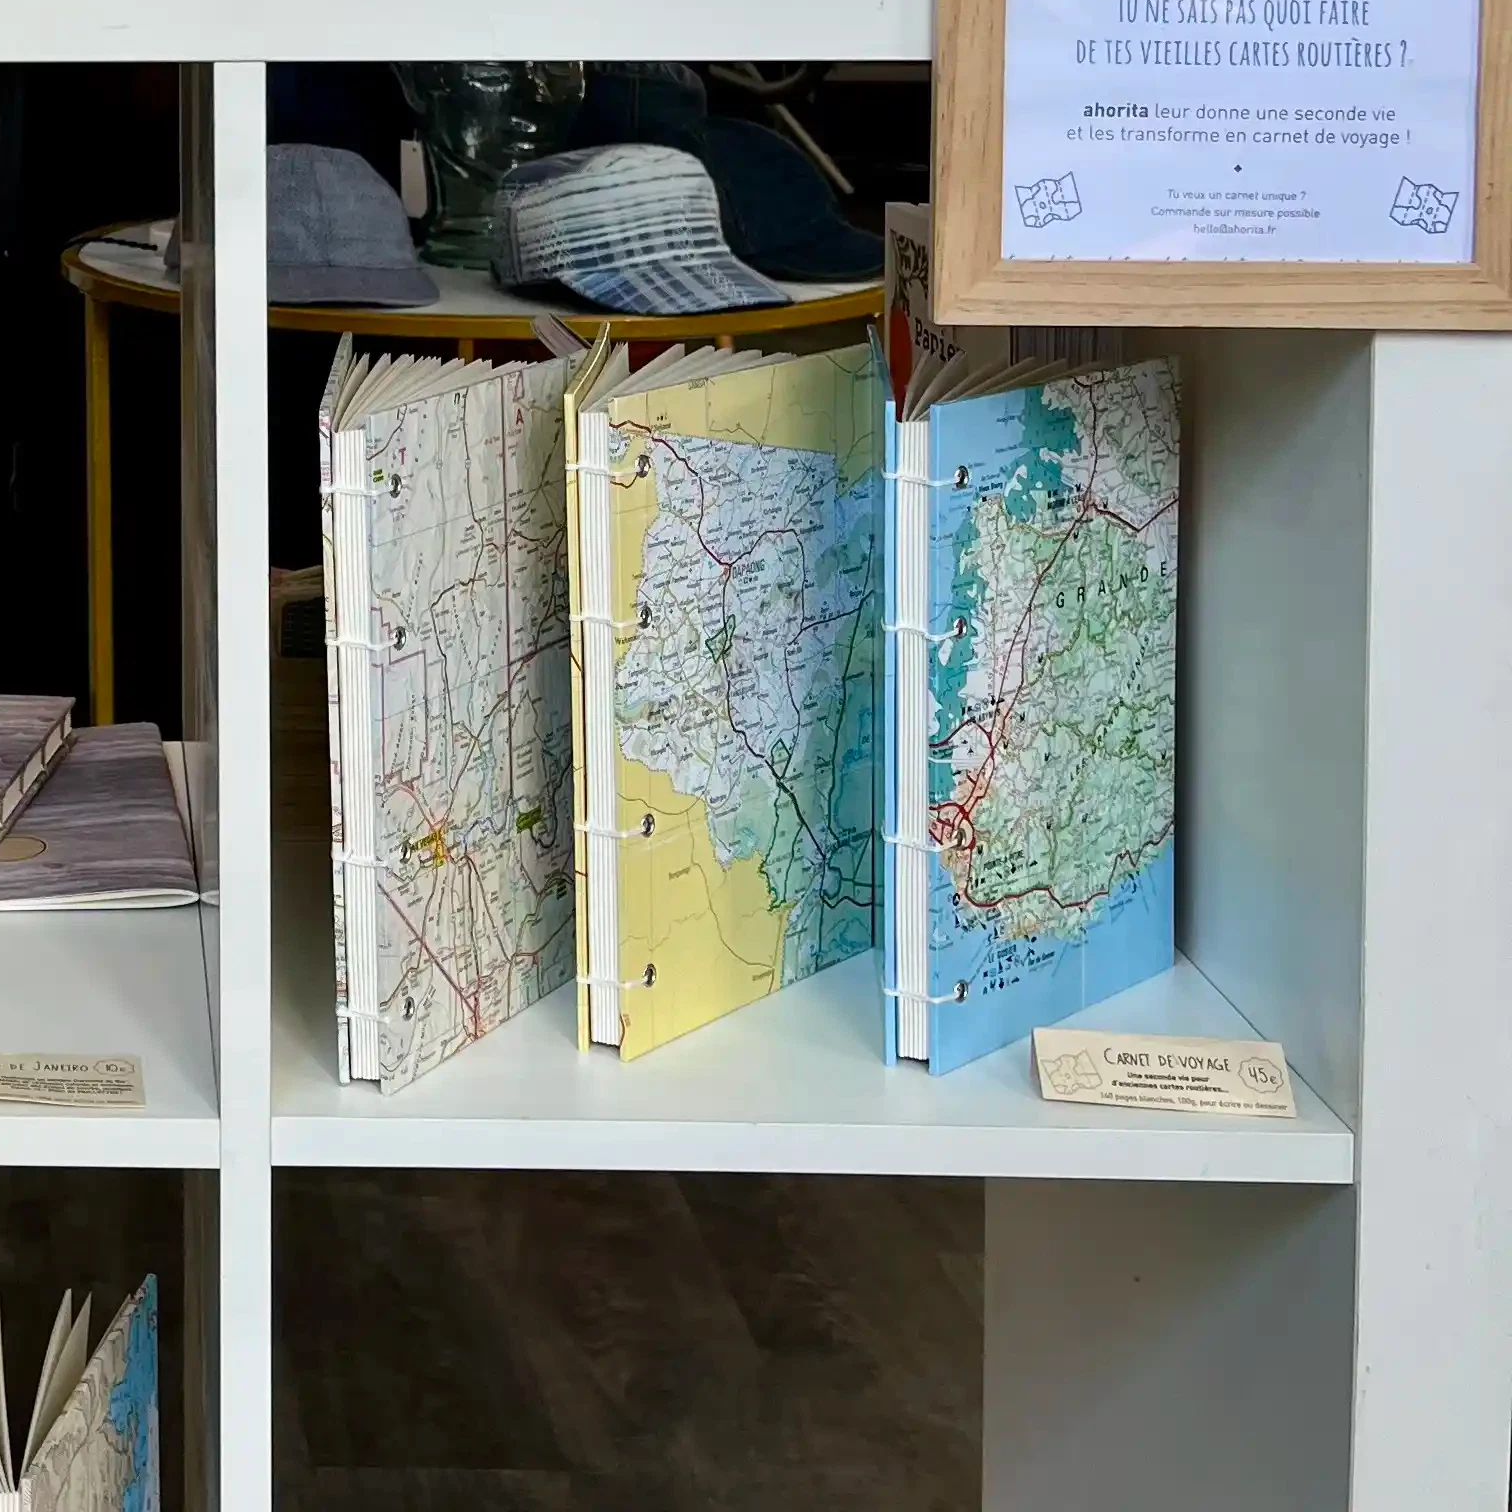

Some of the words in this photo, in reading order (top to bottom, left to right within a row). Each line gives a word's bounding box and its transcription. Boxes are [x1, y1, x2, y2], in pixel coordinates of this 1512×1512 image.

[1263, 0, 1312, 32] QUOI
[1319, 0, 1370, 27] FAIRE
[1076, 38, 1096, 65] DE
[1104, 38, 1133, 65] TES
[1140, 39, 1221, 67] VIEILLES
[1229, 40, 1290, 68] CARTES
[1297, 36, 1392, 68] ROUTIÈRES
[1083, 102, 1149, 120] ahorita
[1155, 104, 1190, 120] leur
[1196, 104, 1250, 121] donne
[1256, 108, 1289, 121] une
[1294, 105, 1367, 122] seconde
[1373, 106, 1396, 122] vie
[1066, 127, 1083, 141] et
[1088, 125, 1115, 141] les
[1120, 125, 1221, 144] transforme
[1225, 130, 1247, 144] en
[1252, 129, 1309, 145] carnet
[1314, 128, 1336, 145] de
[1340, 133, 1401, 149] voyage
[1167, 189, 1179, 201] Tu
[1182, 191, 1205, 201] veux
[1208, 192, 1221, 201] un
[1225, 190, 1258, 202] carnet
[1261, 191, 1297, 204] unique
[1150, 206, 1210, 219] Commande
[1213, 208, 1231, 219] sur
[1234, 209, 1273, 220] mesure
[1277, 206, 1321, 222] possible
[1193, 223, 1276, 236] hello@ahorita.fr
[9, 1062, 26, 1071] DE
[33, 1061, 89, 1073] JANEIRO
[1103, 1047, 1150, 1067] CARNET
[1158, 1055, 1175, 1069] DE
[1178, 1055, 1231, 1073] VOYAGE
[1126, 1071, 1142, 1080] Une
[1144, 1072, 1176, 1081] seconde
[1178, 1074, 1190, 1082] vie
[1191, 1075, 1210, 1085] pour
[1159, 1081, 1184, 1091] cartes
